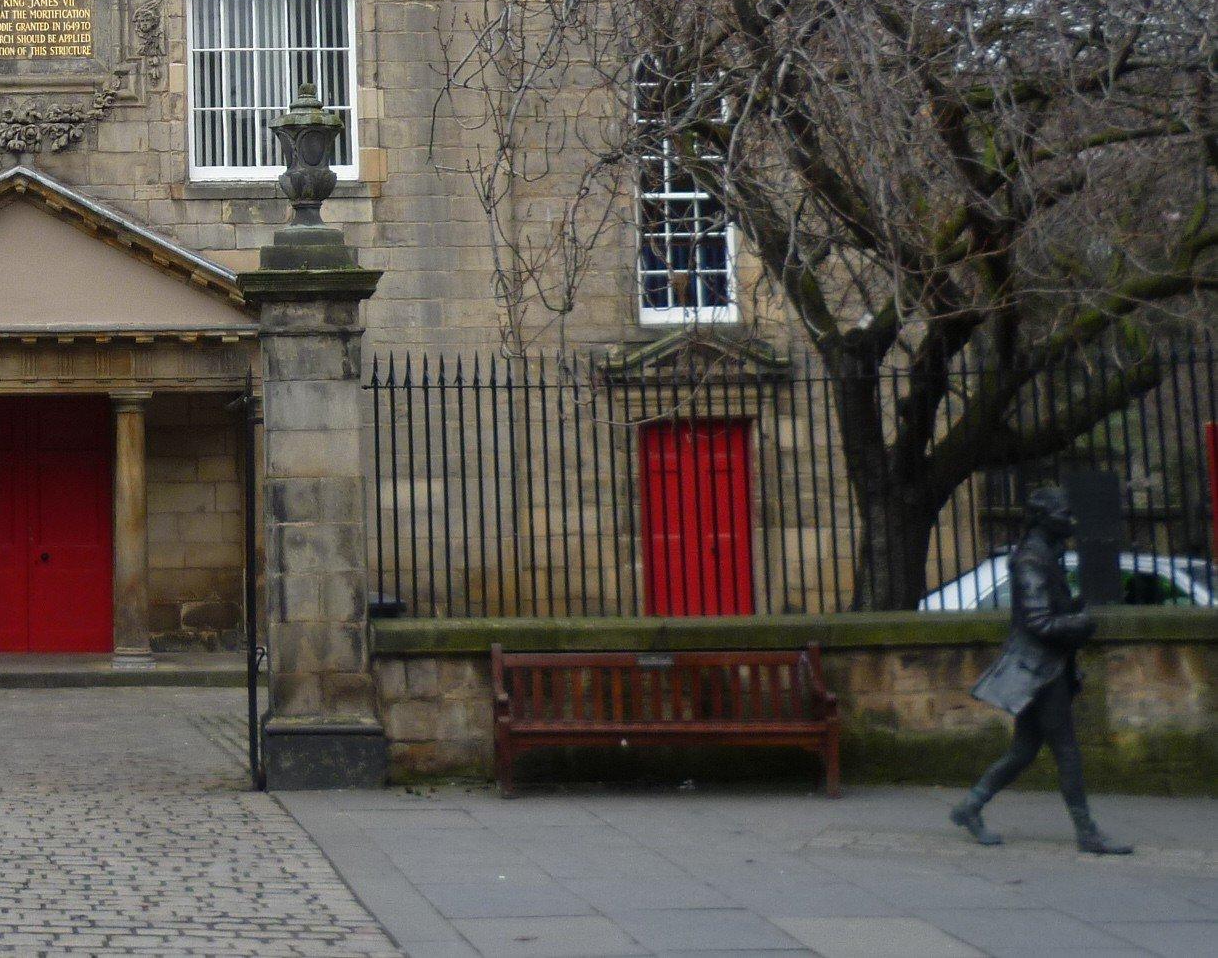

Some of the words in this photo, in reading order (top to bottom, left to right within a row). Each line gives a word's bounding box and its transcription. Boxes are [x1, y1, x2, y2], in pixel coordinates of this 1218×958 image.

[12, 10, 28, 20] THE
[29, 9, 91, 19] MORTIFICATION
[15, 22, 50, 32] GRANTED
[52, 22, 61, 31] IN
[63, 21, 80, 31] 1649
[81, 21, 91, 31] TO
[16, 34, 46, 44] SHOULD
[47, 34, 57, 43] BE
[58, 34, 91, 43] APPLIED
[17, 46, 27, 56] OF
[30, 46, 47, 57] THIS
[49, 46, 92, 56] STRUCTURE
